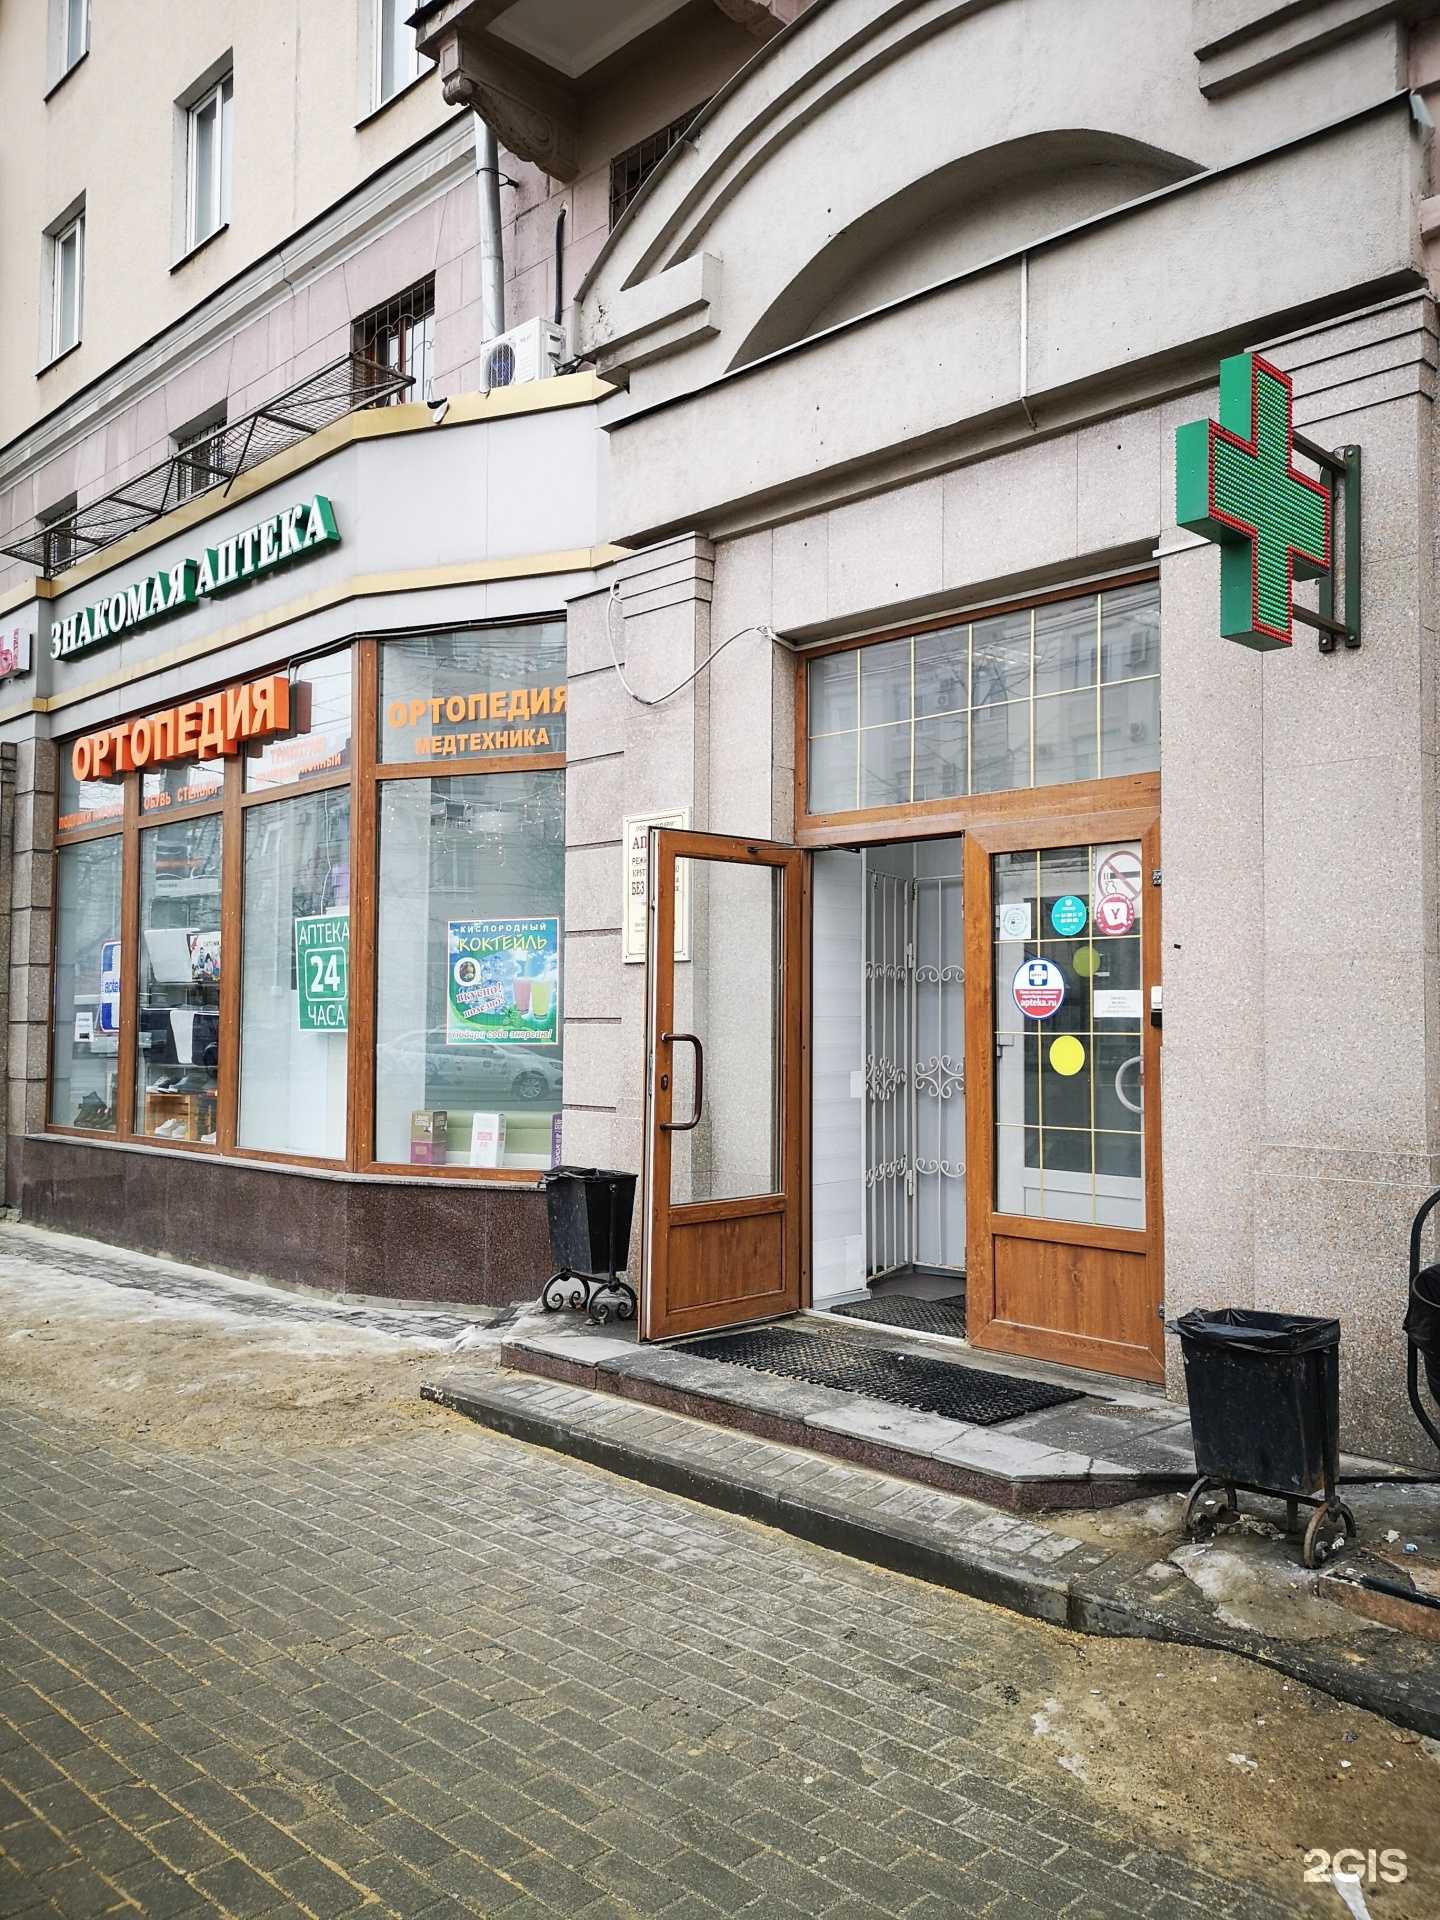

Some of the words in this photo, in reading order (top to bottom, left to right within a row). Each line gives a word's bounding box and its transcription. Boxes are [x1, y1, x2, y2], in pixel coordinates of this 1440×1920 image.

[50, 563, 192, 660] ЗНАКОМАЯ
[196, 496, 333, 597] АПТЕКА
[388, 685, 567, 728] ОРТОПЕДИЯ
[72, 677, 280, 782] ОРТОПЕДИЯ
[415, 727, 550, 755] МЕДТЕХНИКА
[299, 921, 350, 945] АПТЕКА
[460, 922, 547, 933] КИСЛОРОДНЫЙ
[459, 934, 548, 952] КОКТЕЙЛЬ
[310, 954, 341, 993] 24
[307, 1004, 346, 1026] ЧАСА
[1020, 998, 1057, 1009] apteka.ru
